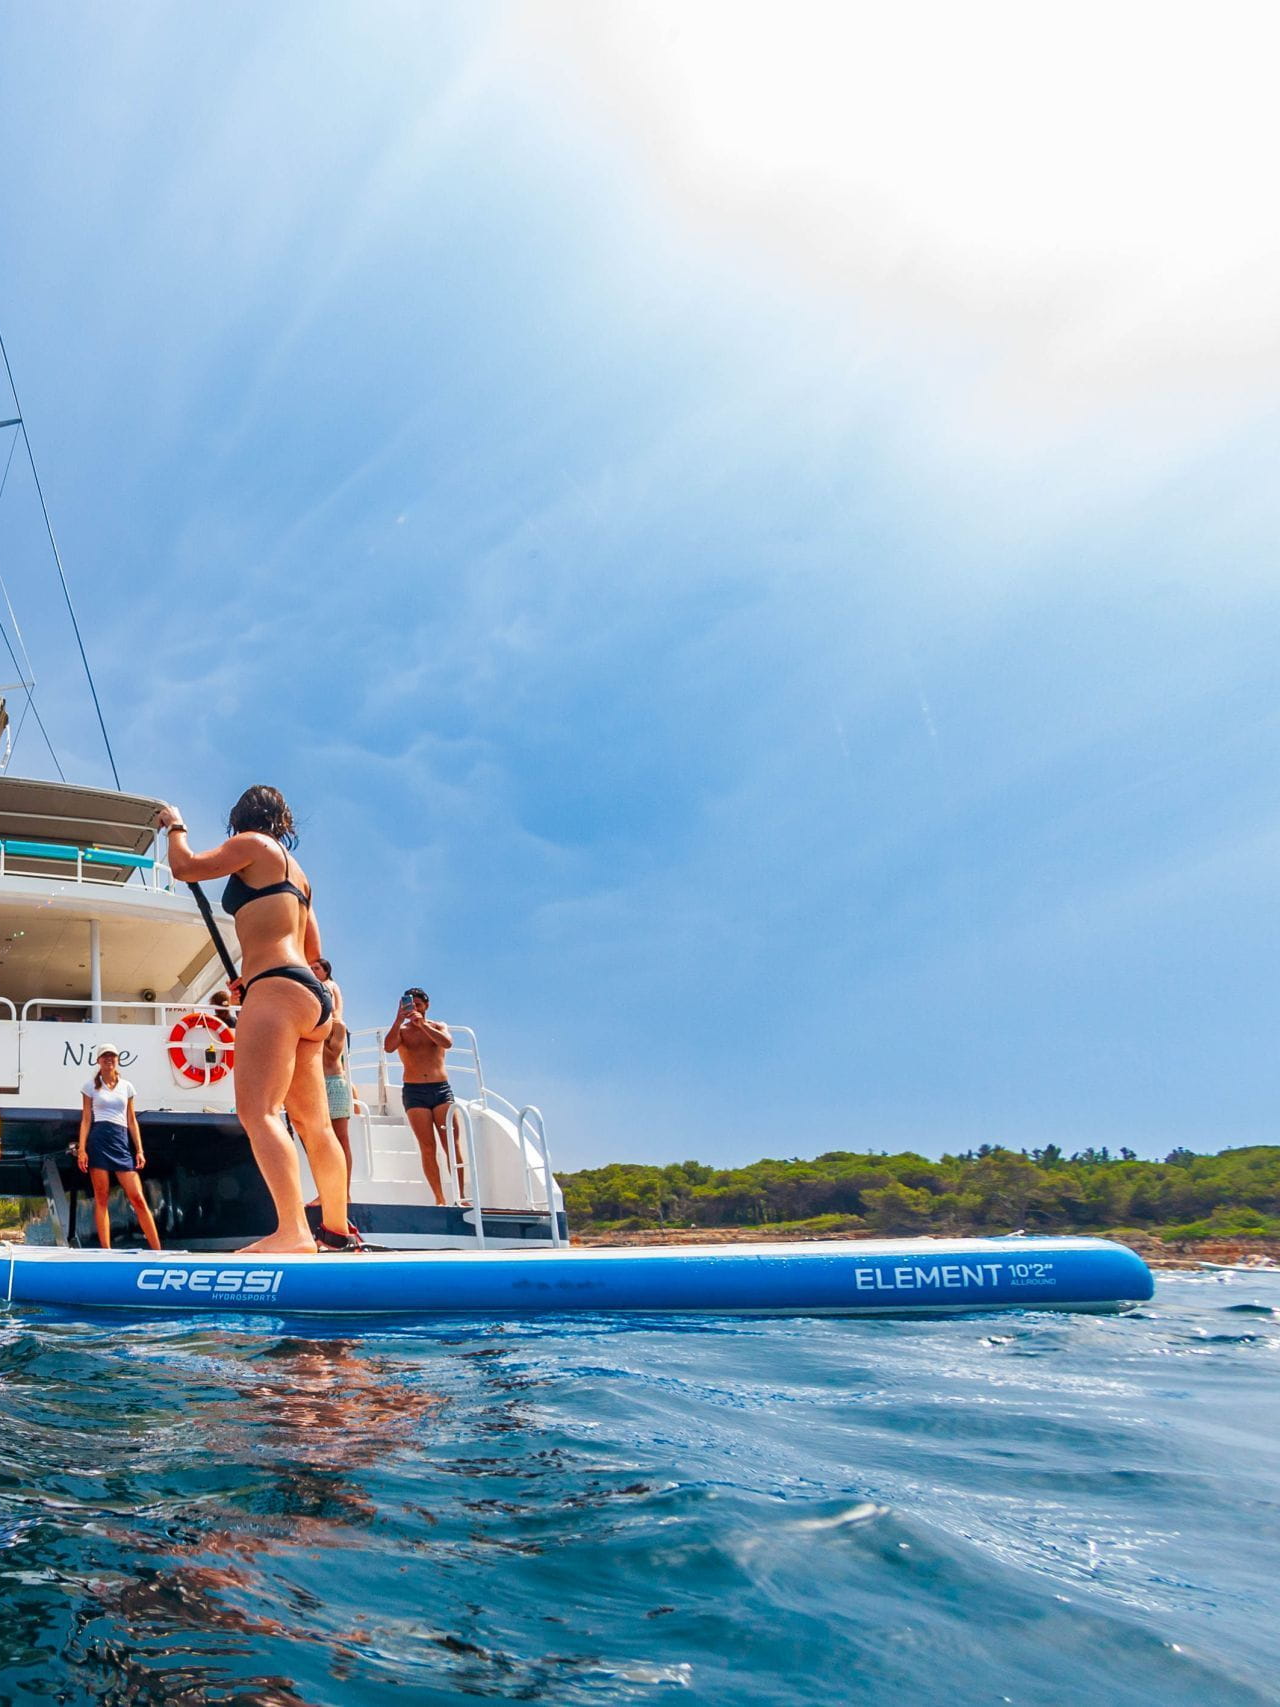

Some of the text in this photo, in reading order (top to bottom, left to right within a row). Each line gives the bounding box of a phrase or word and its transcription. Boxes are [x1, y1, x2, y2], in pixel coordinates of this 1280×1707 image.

[63, 1041, 138, 1067] Nie
[136, 1268, 284, 1293] CRESSI
[854, 1263, 1003, 1290] ELEMENT
[1010, 1278, 1057, 1286] ALLROUND
[211, 1293, 277, 1302] HYDROSPORTS
